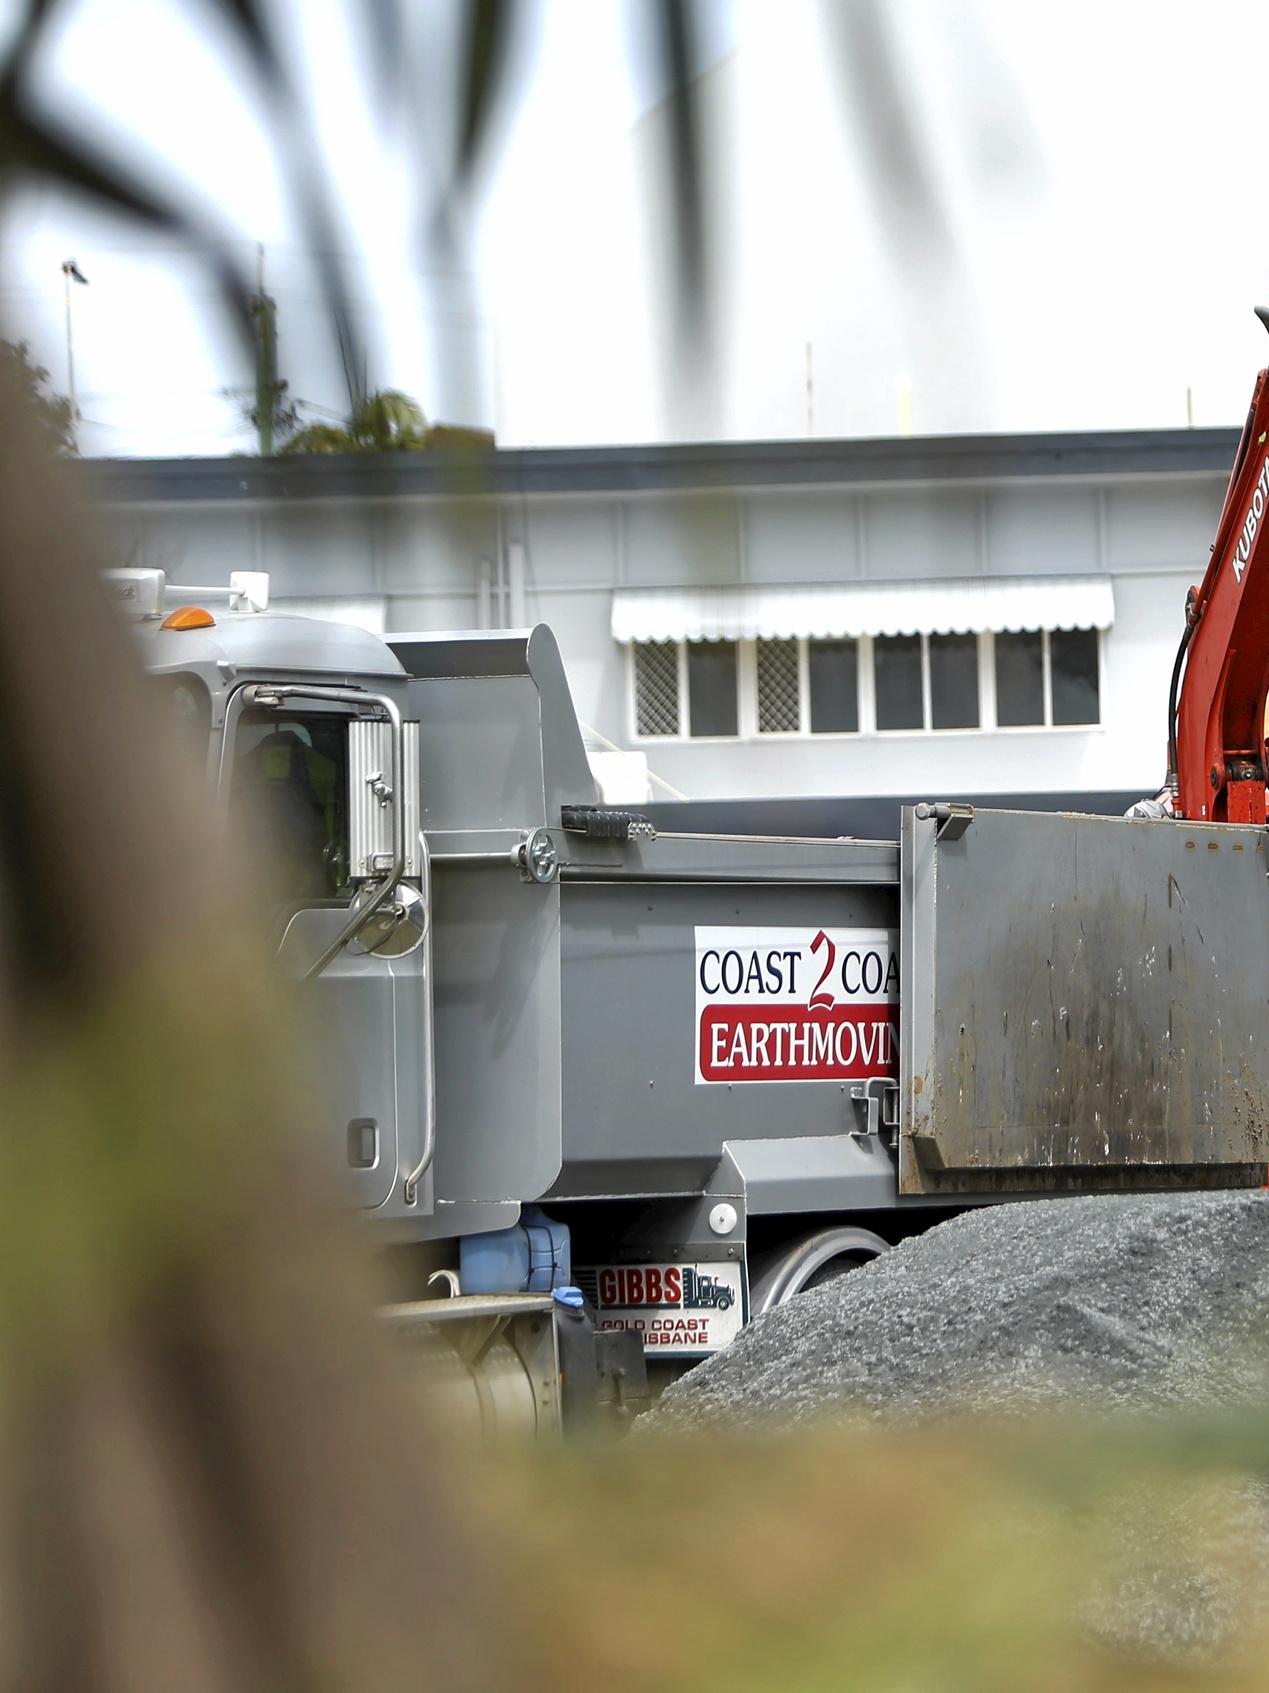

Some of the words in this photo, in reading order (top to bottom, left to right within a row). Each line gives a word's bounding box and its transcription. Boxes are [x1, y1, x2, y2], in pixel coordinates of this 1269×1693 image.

[700, 950, 802, 995] COAST
[809, 930, 836, 1010] 2
[600, 1267, 682, 1304] GIBBS
[602, 1320, 646, 1331] GOLD
[651, 1319, 710, 1331] COAST
